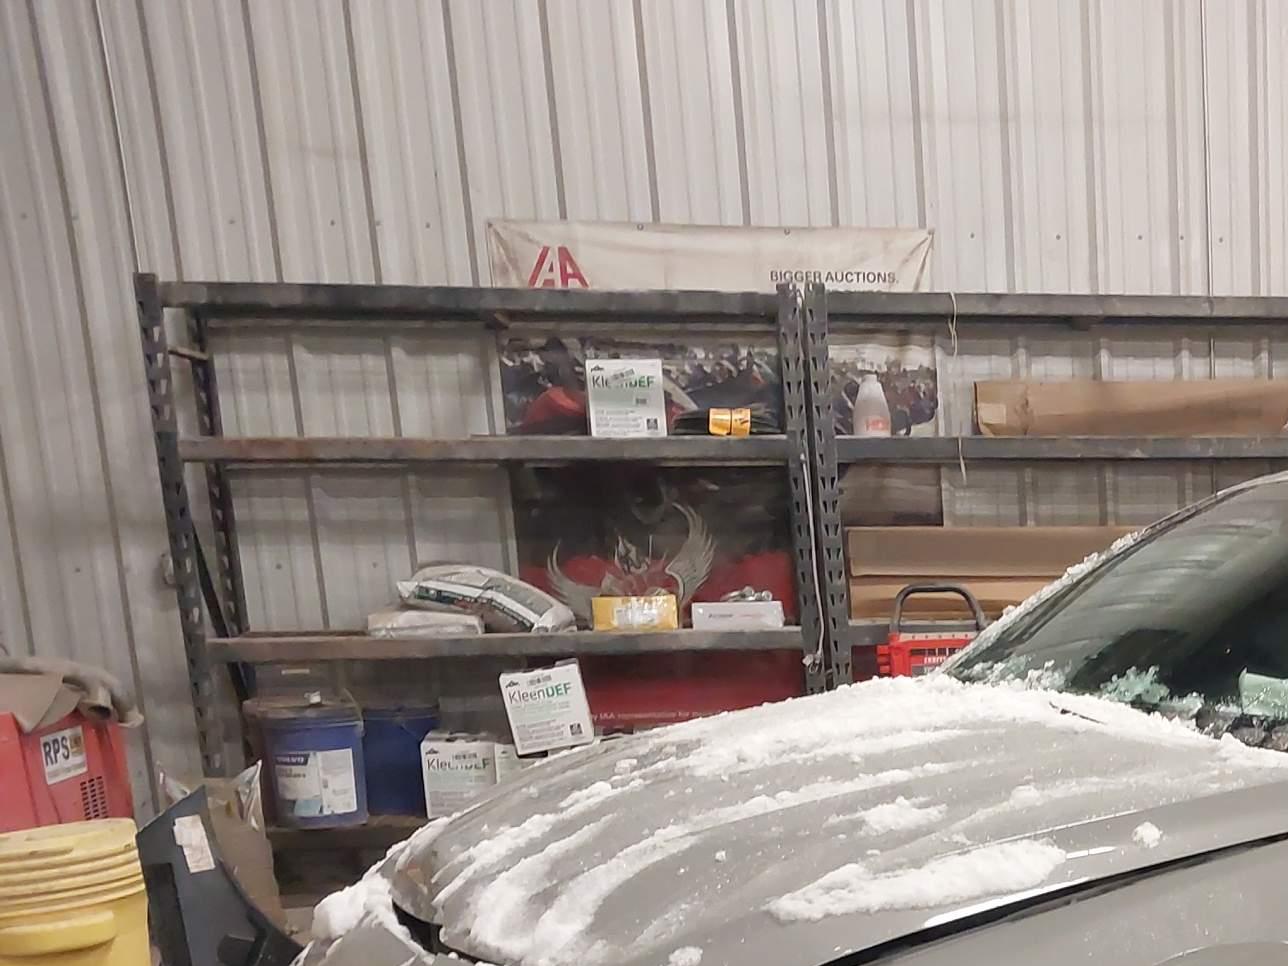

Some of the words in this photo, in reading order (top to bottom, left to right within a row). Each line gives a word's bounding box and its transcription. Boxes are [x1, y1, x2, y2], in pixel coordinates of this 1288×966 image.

[769, 270, 821, 282] BIGGER
[508, 682, 572, 705] KleenDEF
[43, 736, 70, 767] RPS
